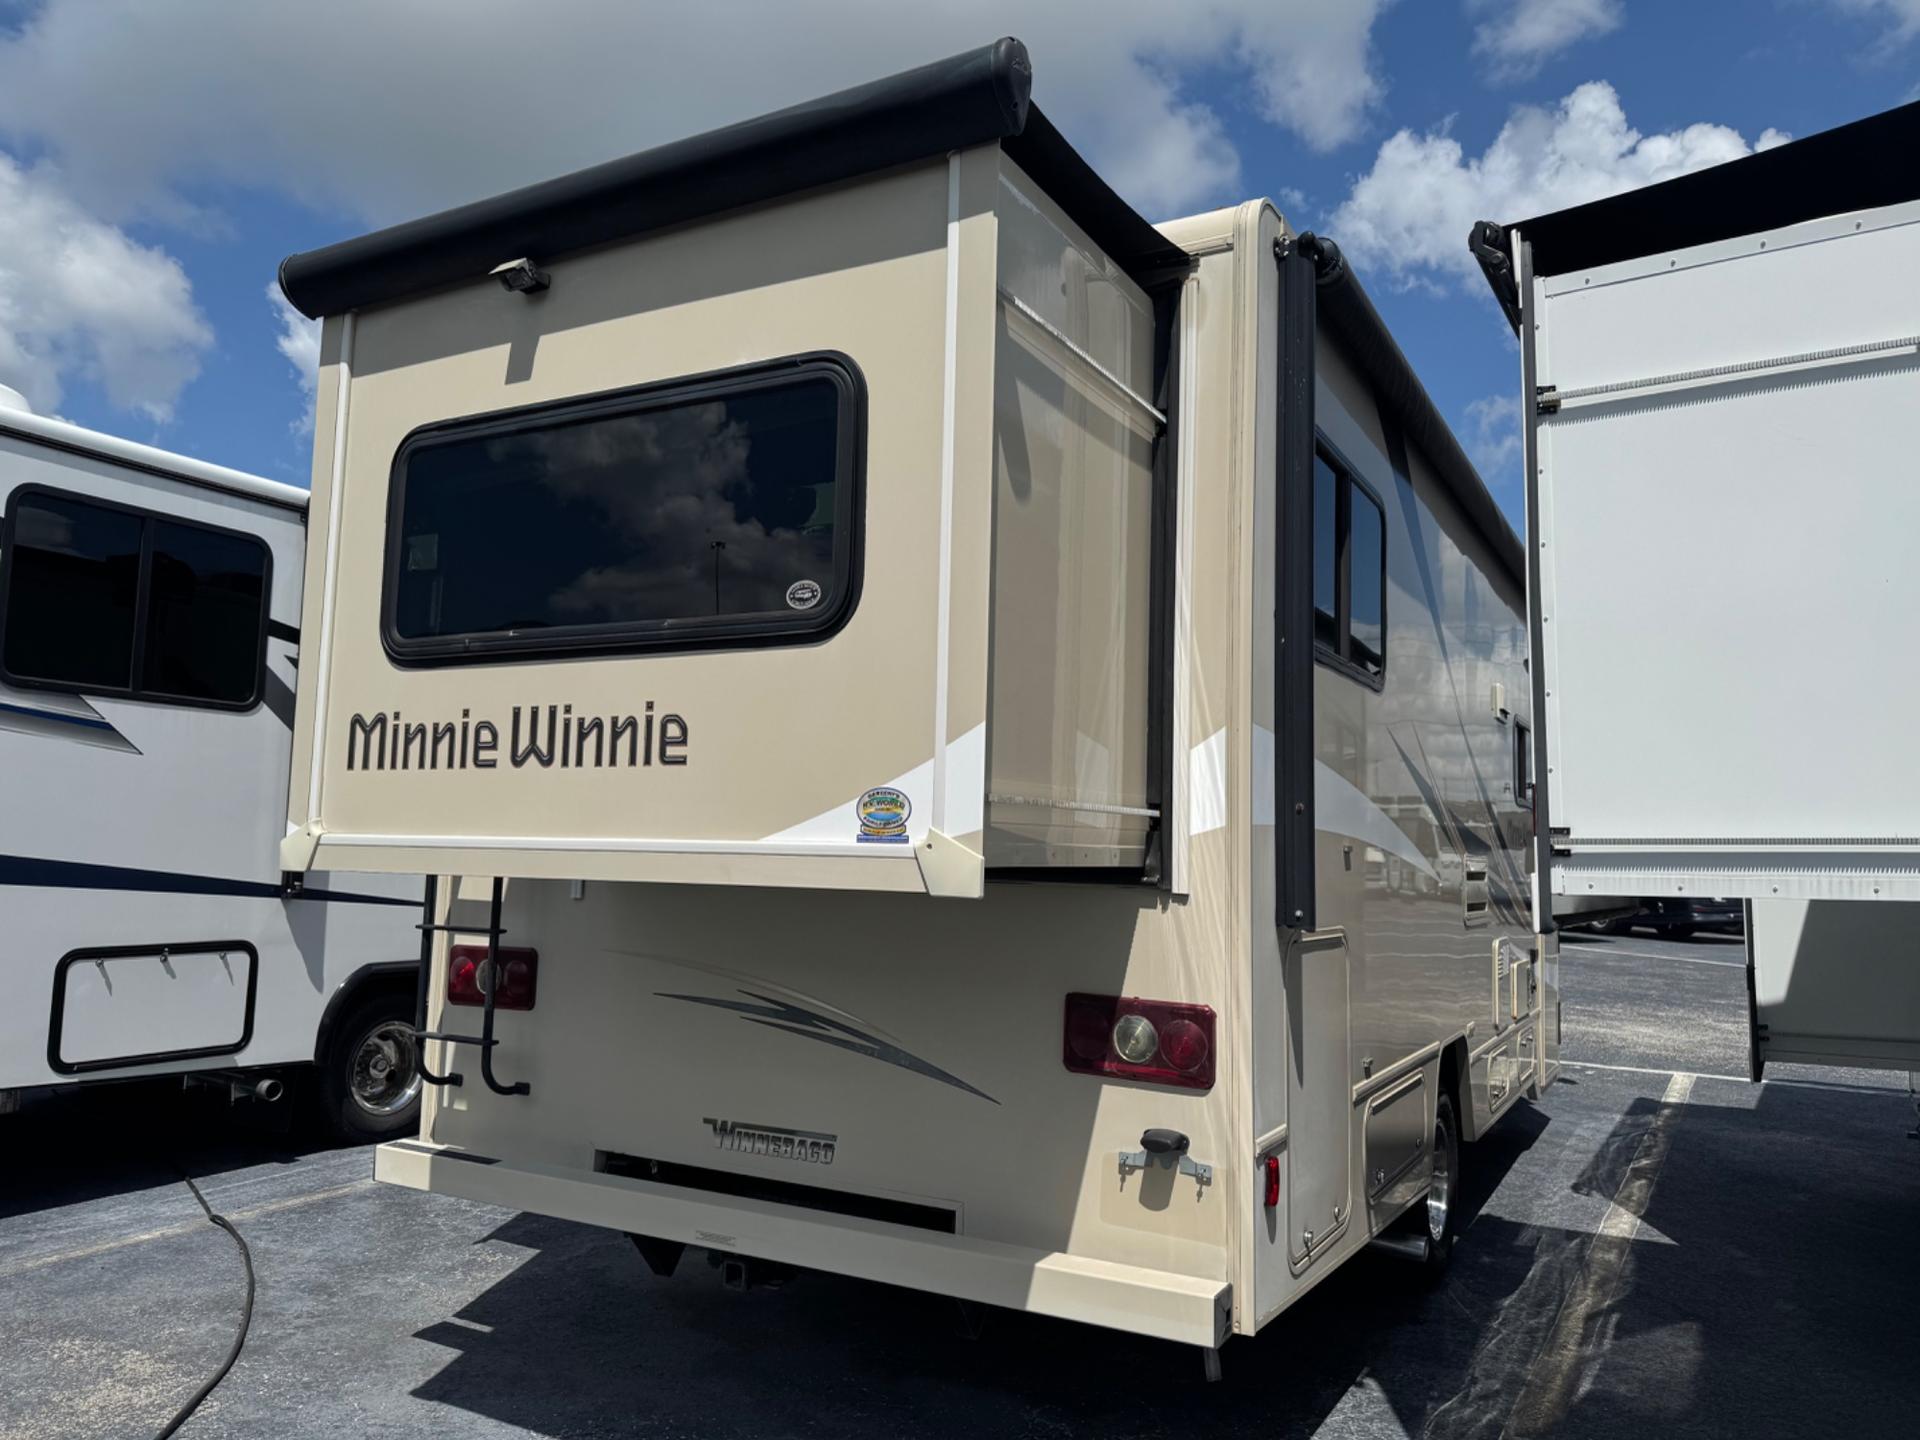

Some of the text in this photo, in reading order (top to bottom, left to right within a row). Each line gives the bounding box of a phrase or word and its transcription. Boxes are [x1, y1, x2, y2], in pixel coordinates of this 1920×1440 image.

[347, 701, 688, 770] Minnie Winnie
[703, 1117, 837, 1164] WINNEBAGO
